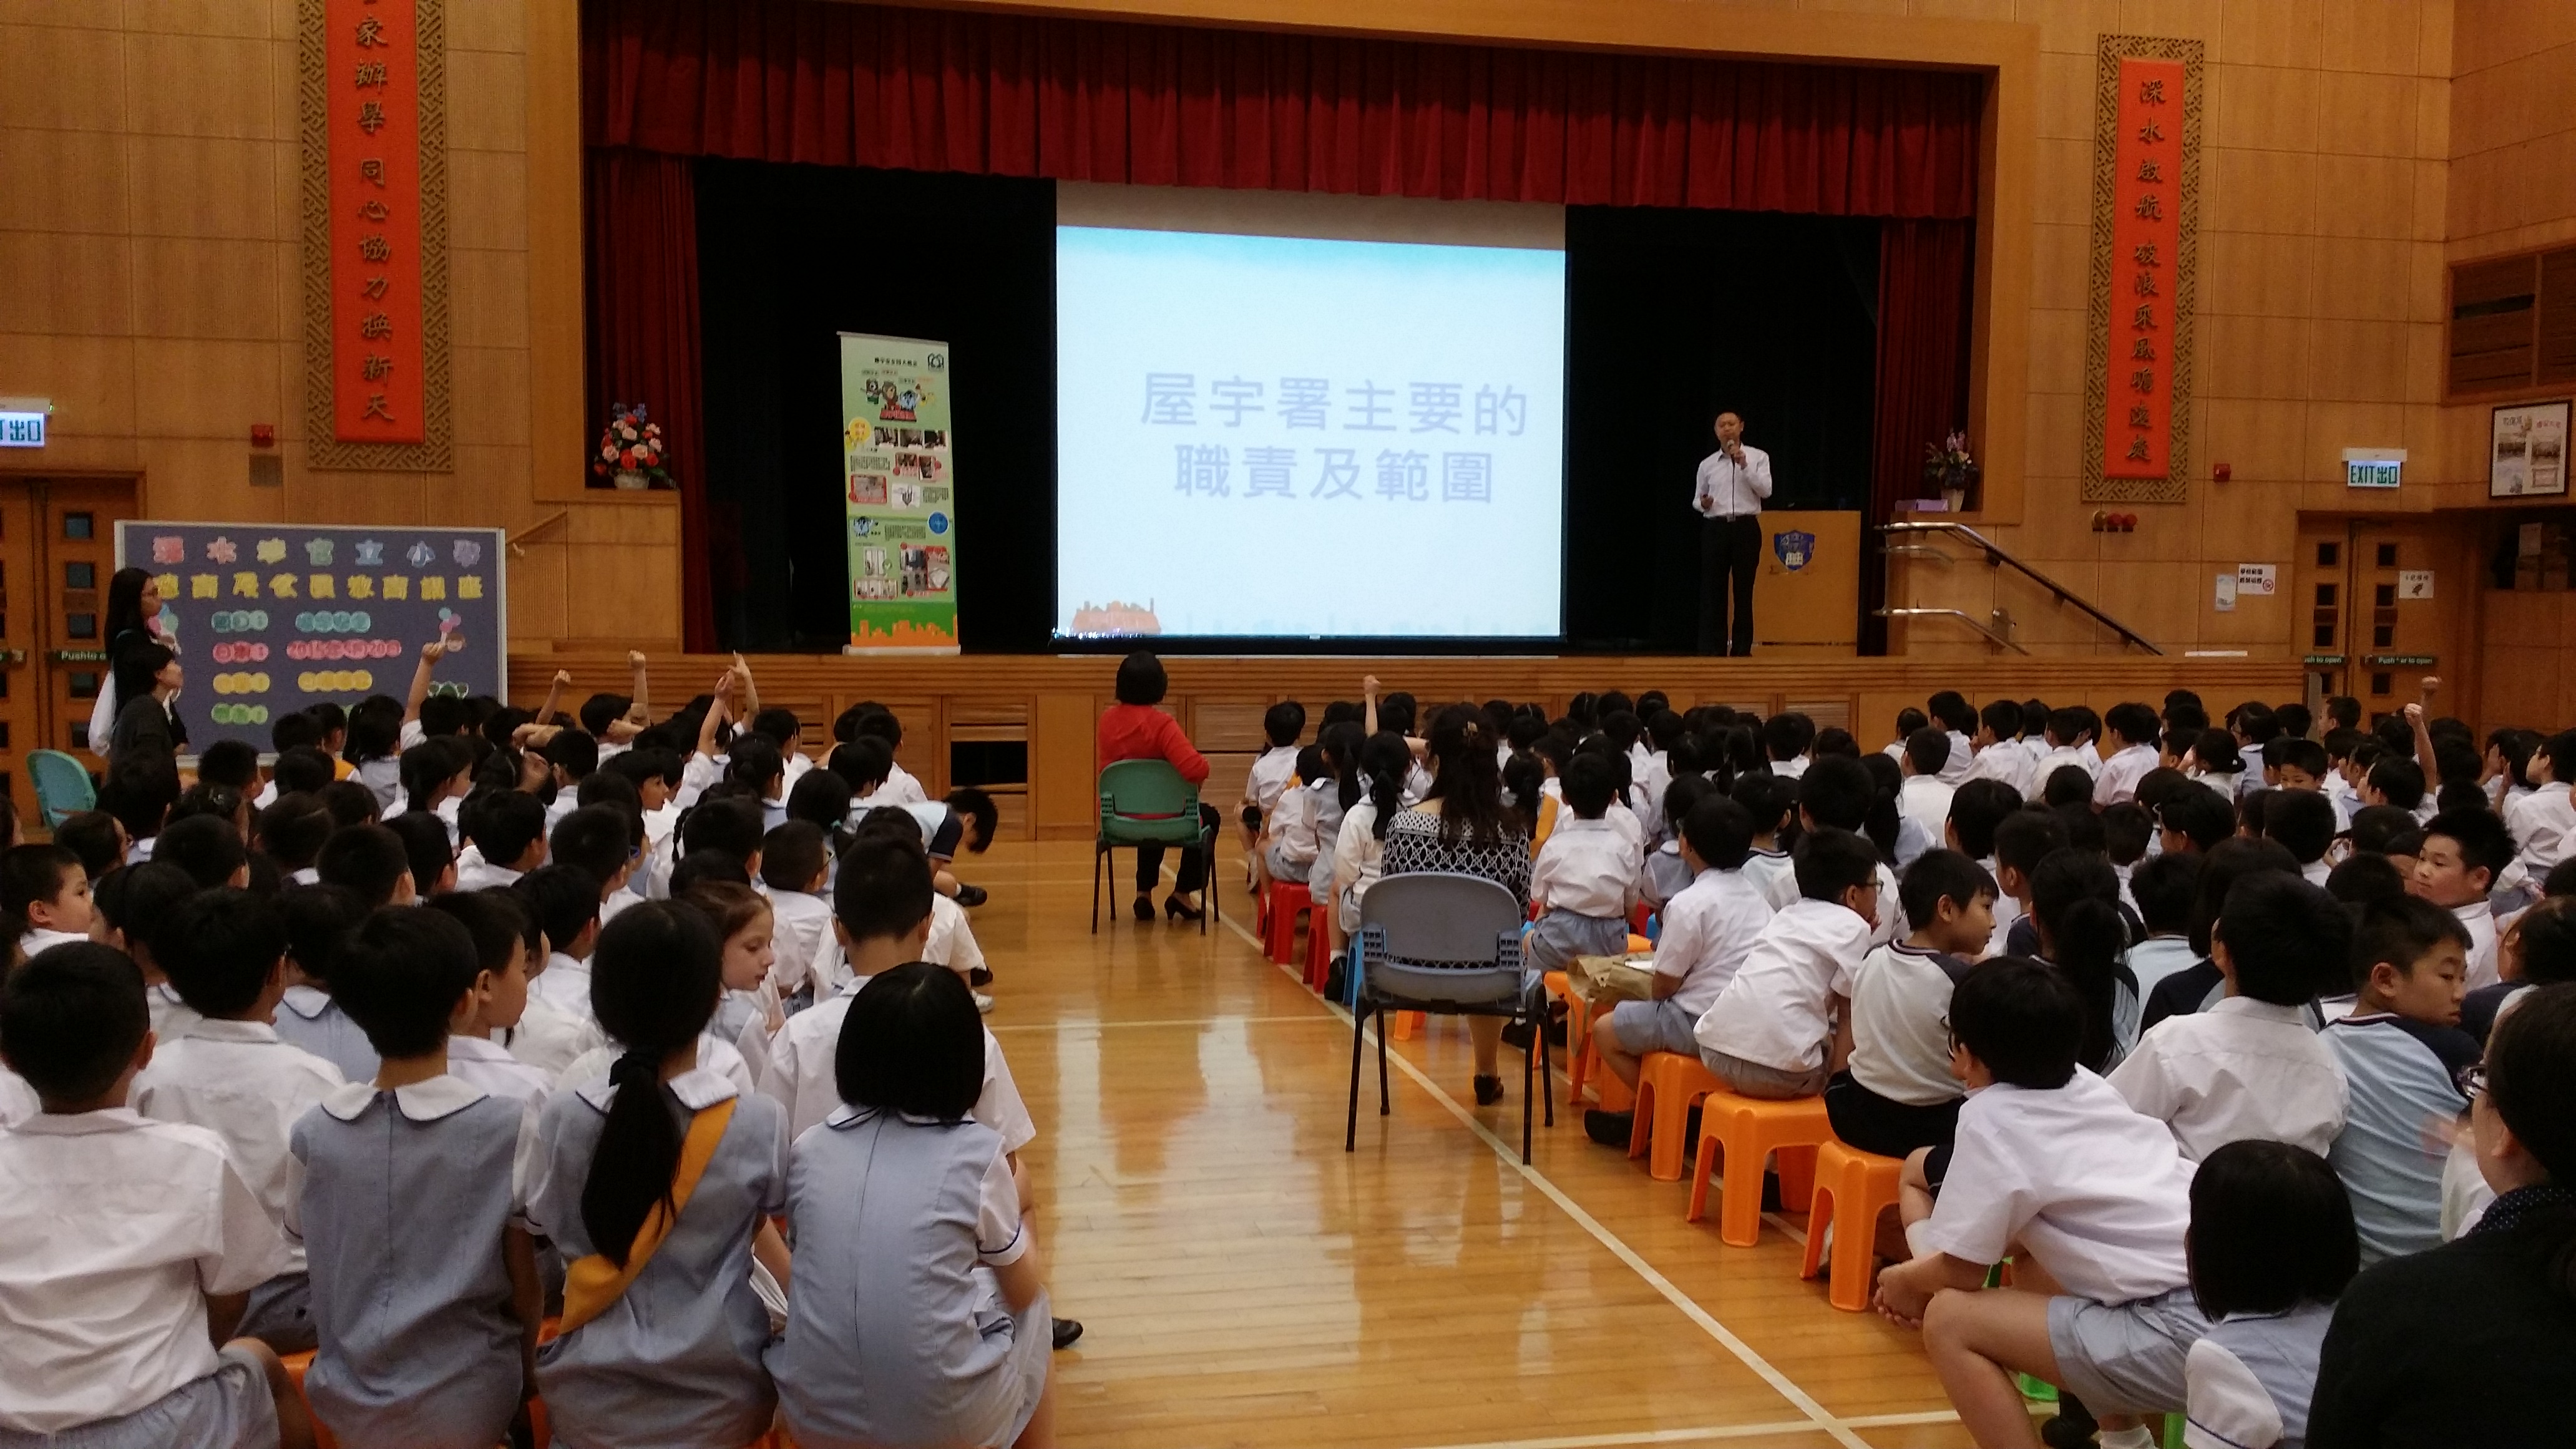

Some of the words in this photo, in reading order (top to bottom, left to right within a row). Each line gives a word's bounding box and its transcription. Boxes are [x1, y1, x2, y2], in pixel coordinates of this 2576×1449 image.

[1141, 373, 1528, 437] 屋宇署主要的
[9, 419, 41, 441] 出口
[1173, 444, 1494, 504] 職責及範圍
[2351, 465, 2374, 483] EXIT
[2377, 466, 2398, 484] 出口
